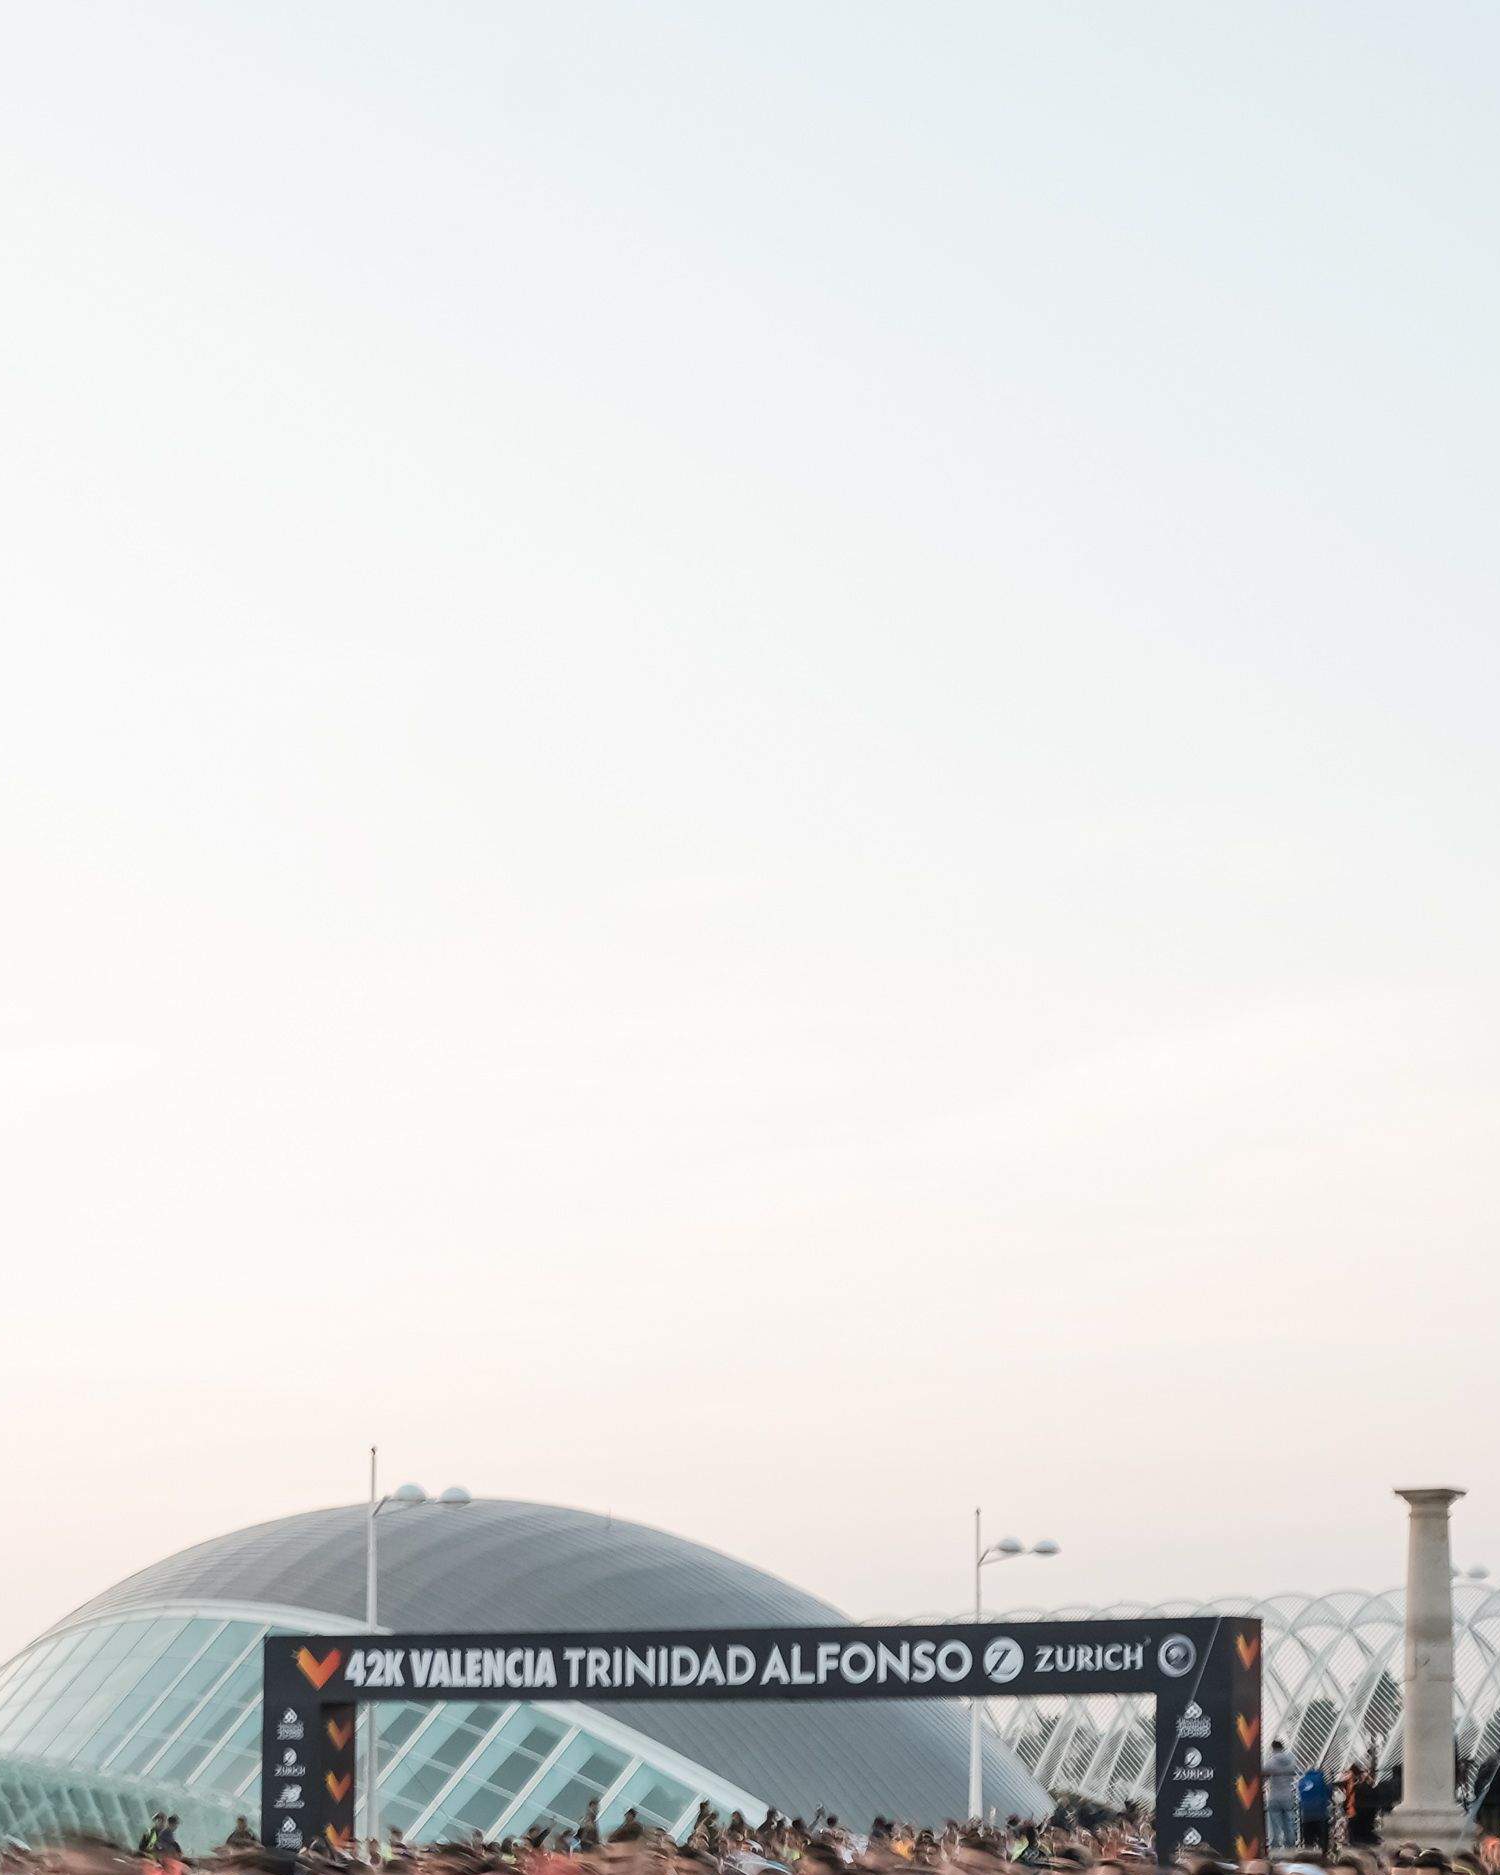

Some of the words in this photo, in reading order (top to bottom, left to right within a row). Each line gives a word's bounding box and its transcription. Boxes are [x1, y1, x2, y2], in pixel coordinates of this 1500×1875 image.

[342, 1647, 406, 1688] 42K
[408, 1647, 558, 1688] VALENCIA
[563, 1644, 757, 1688] TRINIDAD
[759, 1639, 974, 1685] ALFONSO
[1033, 1642, 1145, 1673] ZURICH
